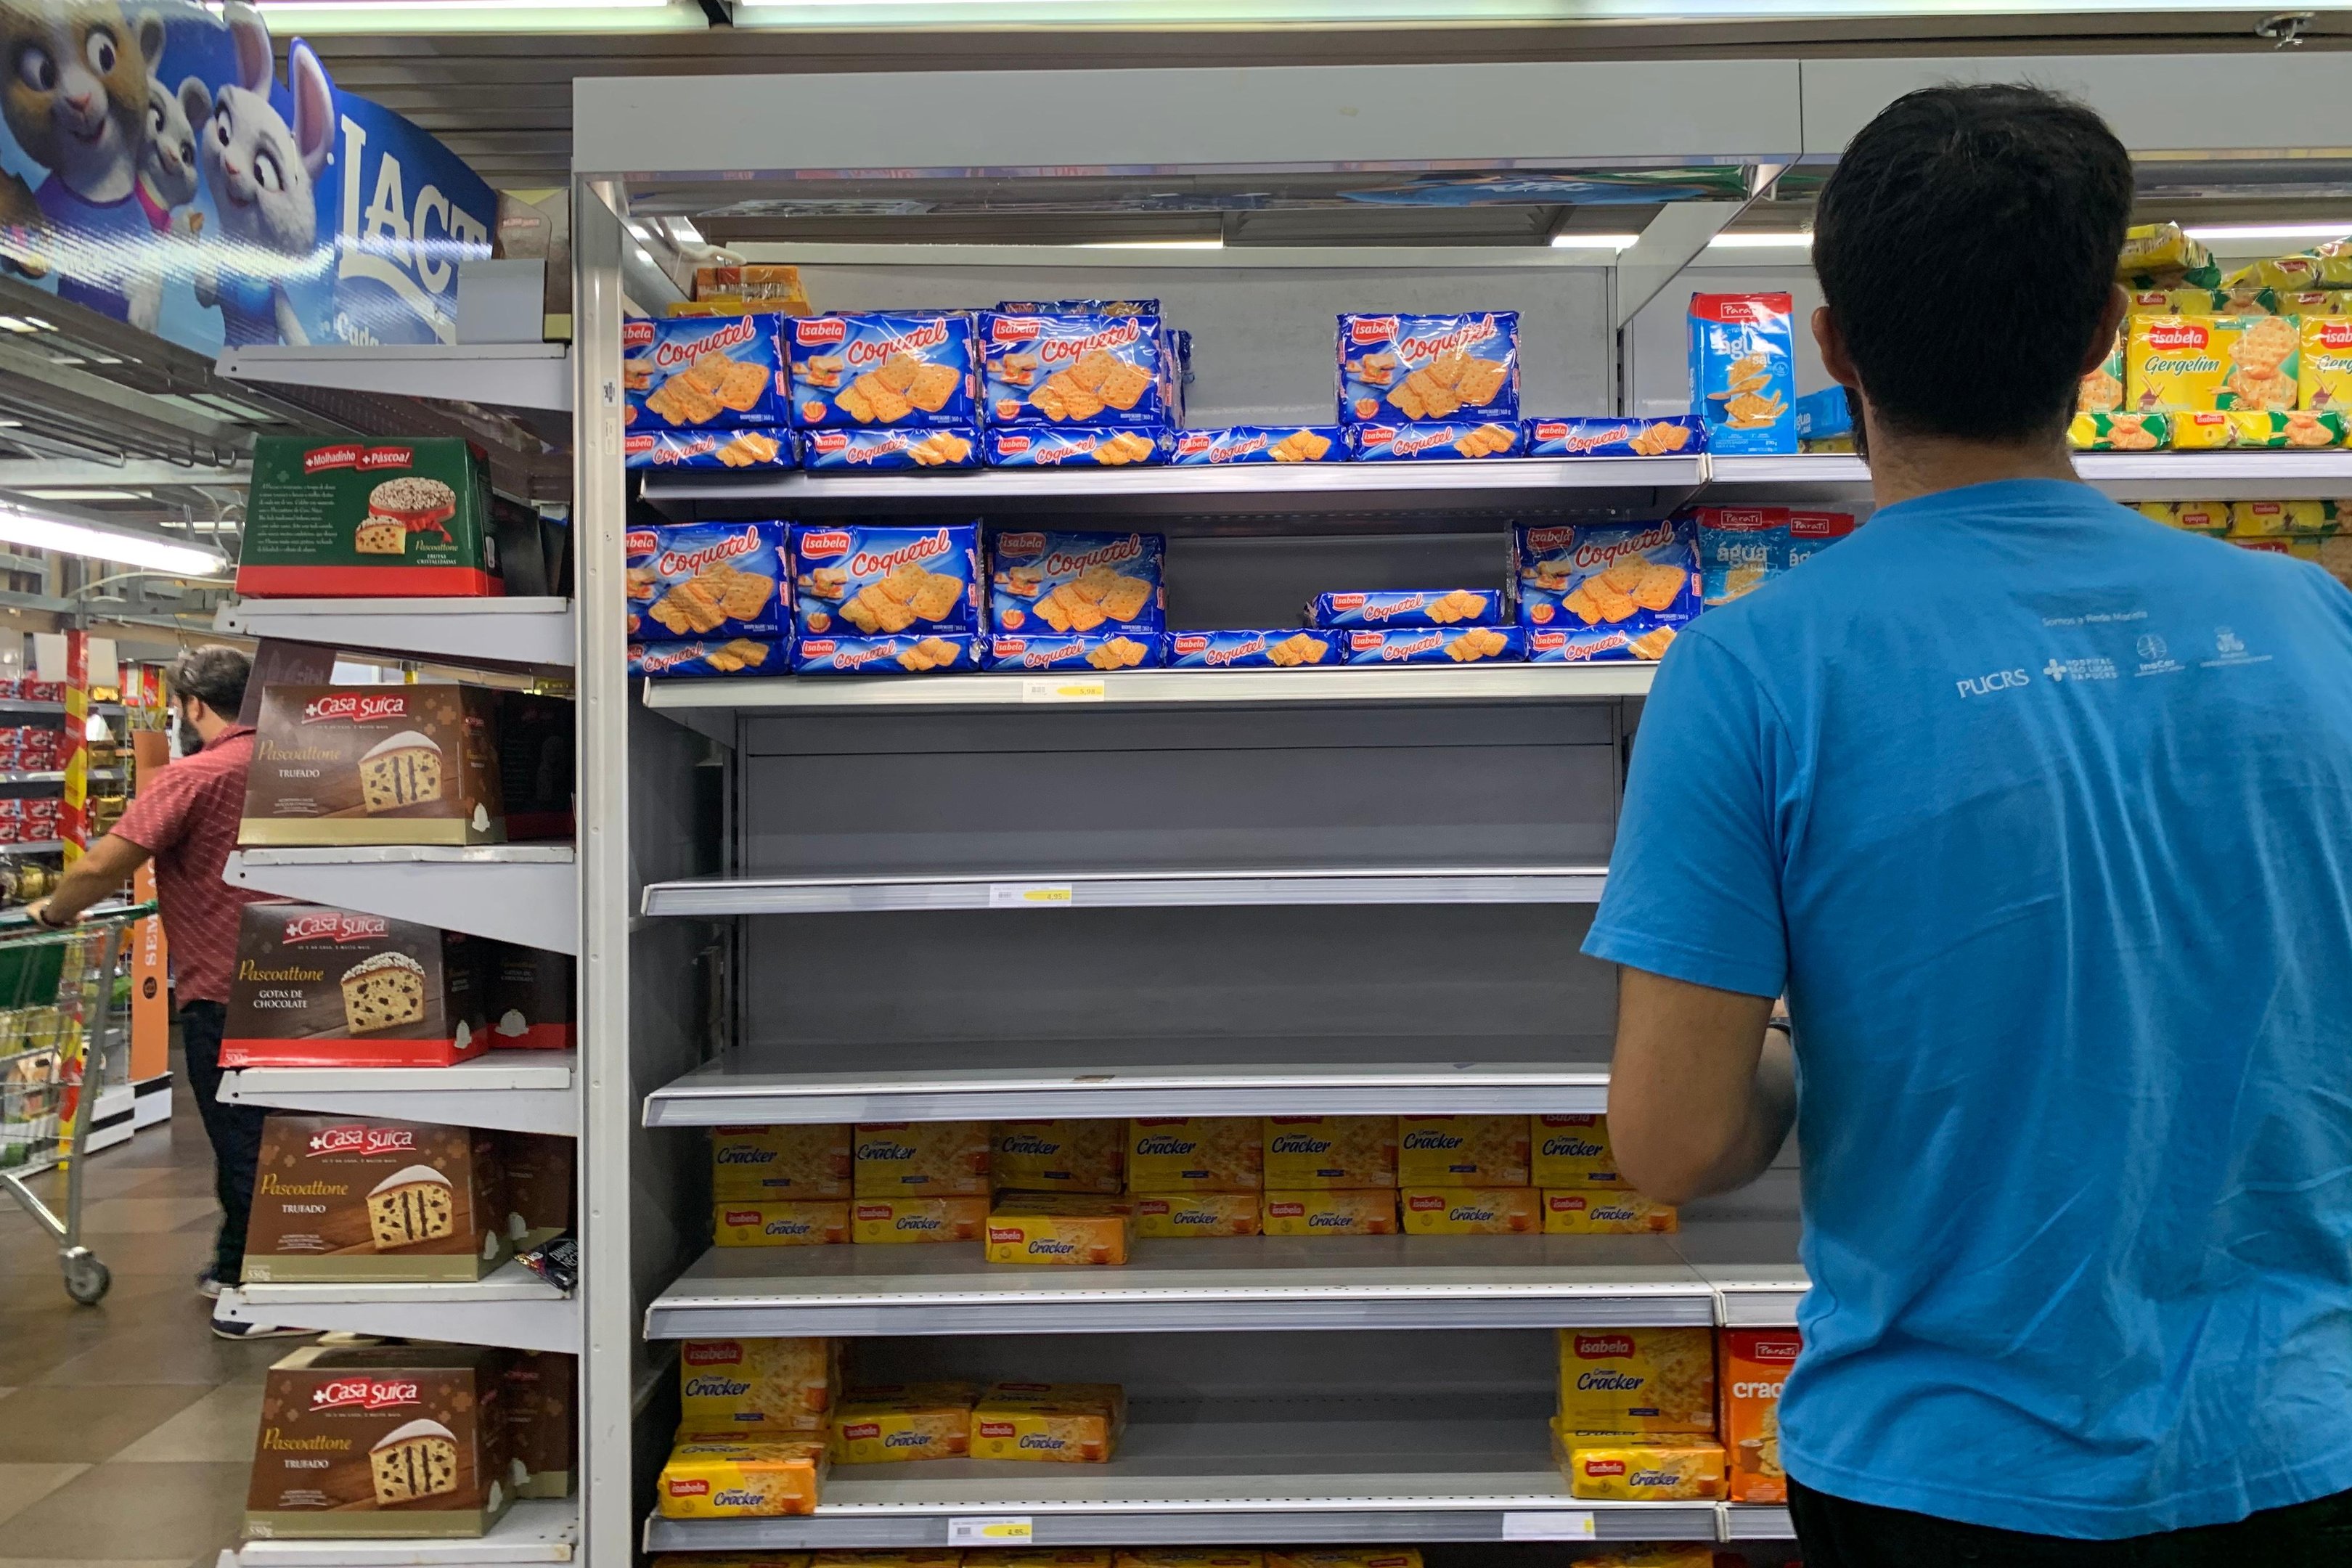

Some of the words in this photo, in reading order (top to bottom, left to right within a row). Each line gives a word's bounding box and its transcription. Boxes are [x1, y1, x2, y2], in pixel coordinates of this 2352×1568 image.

[1723, 305, 1757, 315] Para
[801, 325, 843, 338] isabela
[2154, 329, 2202, 344] isabela
[657, 314, 756, 367] Coquetel
[848, 317, 948, 367] Coquetel
[1040, 317, 1141, 364] Coquetel
[1752, 354, 1772, 365] sal
[2144, 356, 2220, 376] Gergelim
[1796, 412, 1810, 430] gua
[2197, 415, 2224, 424] isabela
[1365, 429, 1393, 441] isabela
[1538, 425, 1567, 436] isabela
[816, 437, 845, 447] isabela
[1000, 438, 1029, 449] isabela
[1393, 426, 1454, 457] Coquetel
[1567, 425, 1628, 453] Coquetel
[846, 434, 907, 464] Coquetel
[1034, 435, 1096, 465] Coquetel
[1209, 432, 1268, 463] Coquetel
[1724, 513, 1758, 522] Parati
[1794, 520, 1826, 529] Parati
[805, 536, 847, 549] isabela
[1003, 536, 1042, 549] isabela
[1530, 530, 1572, 543] isabela
[1575, 520, 1675, 569] Coquetel
[660, 525, 761, 576] Coquetel
[851, 527, 952, 578] Coquetel
[1047, 534, 1143, 578] Coquetel
[1717, 541, 1768, 565] água
[1334, 595, 1363, 605] isabela
[1363, 592, 1424, 622] Coquetel
[804, 642, 834, 653] isabela
[995, 641, 1024, 652] isabela
[1177, 638, 1205, 650] isabela
[1353, 635, 1382, 647] isabela
[1382, 631, 1444, 661] Coquetel
[1535, 634, 1564, 645] isabela
[1565, 630, 1627, 661] Coquetel
[643, 641, 704, 672] Coquetel
[834, 640, 897, 669] Coquetel
[1024, 639, 1086, 669] Coquetel
[1205, 637, 1266, 666] Coquetel
[1956, 669, 2030, 698] PUCRS
[360, 697, 404, 716] Suíça
[258, 740, 340, 761] Pascoattone
[279, 769, 320, 778] TRUFADO
[341, 918, 385, 937] Suíça
[239, 960, 324, 981] Pascoattone
[259, 989, 286, 999] GOTAS
[287, 989, 303, 998] DE
[253, 1000, 308, 1008] CHOCOLATE
[367, 1130, 412, 1150] Suíça
[1002, 1136, 1060, 1155] Cracker
[1137, 1138, 1196, 1155] Cracker
[1272, 1136, 1331, 1153] Cracker
[1403, 1132, 1463, 1150] Cracker
[1542, 1139, 1604, 1156] Cracker
[717, 1146, 777, 1164] Cracker
[857, 1143, 916, 1161] Cracker
[261, 1173, 349, 1196] Pascoattone
[1174, 1212, 1218, 1225] Cracker
[1309, 1214, 1353, 1227] Cracker
[1449, 1208, 1494, 1221] Cracker
[1590, 1208, 1634, 1220] Cracker
[766, 1221, 810, 1235] Cracker
[897, 1217, 941, 1230] Cracker
[992, 1230, 1021, 1241] isabela
[1029, 1241, 1074, 1254] Cracker
[690, 1347, 737, 1359] isabela
[1580, 1339, 1629, 1353] isabela
[1759, 1345, 1796, 1355] Parati
[685, 1379, 751, 1397] Cracker
[1577, 1372, 1643, 1391] Cracker
[371, 1383, 417, 1404] Suíça
[264, 1428, 353, 1450] Pascoattone
[885, 1434, 932, 1447] Cracker
[1019, 1434, 1066, 1449] Cracker
[285, 1459, 329, 1469] TRUFADO
[1588, 1462, 1622, 1473] isabela
[1629, 1472, 1680, 1486] Cracker
[714, 1492, 764, 1507] Cracker
